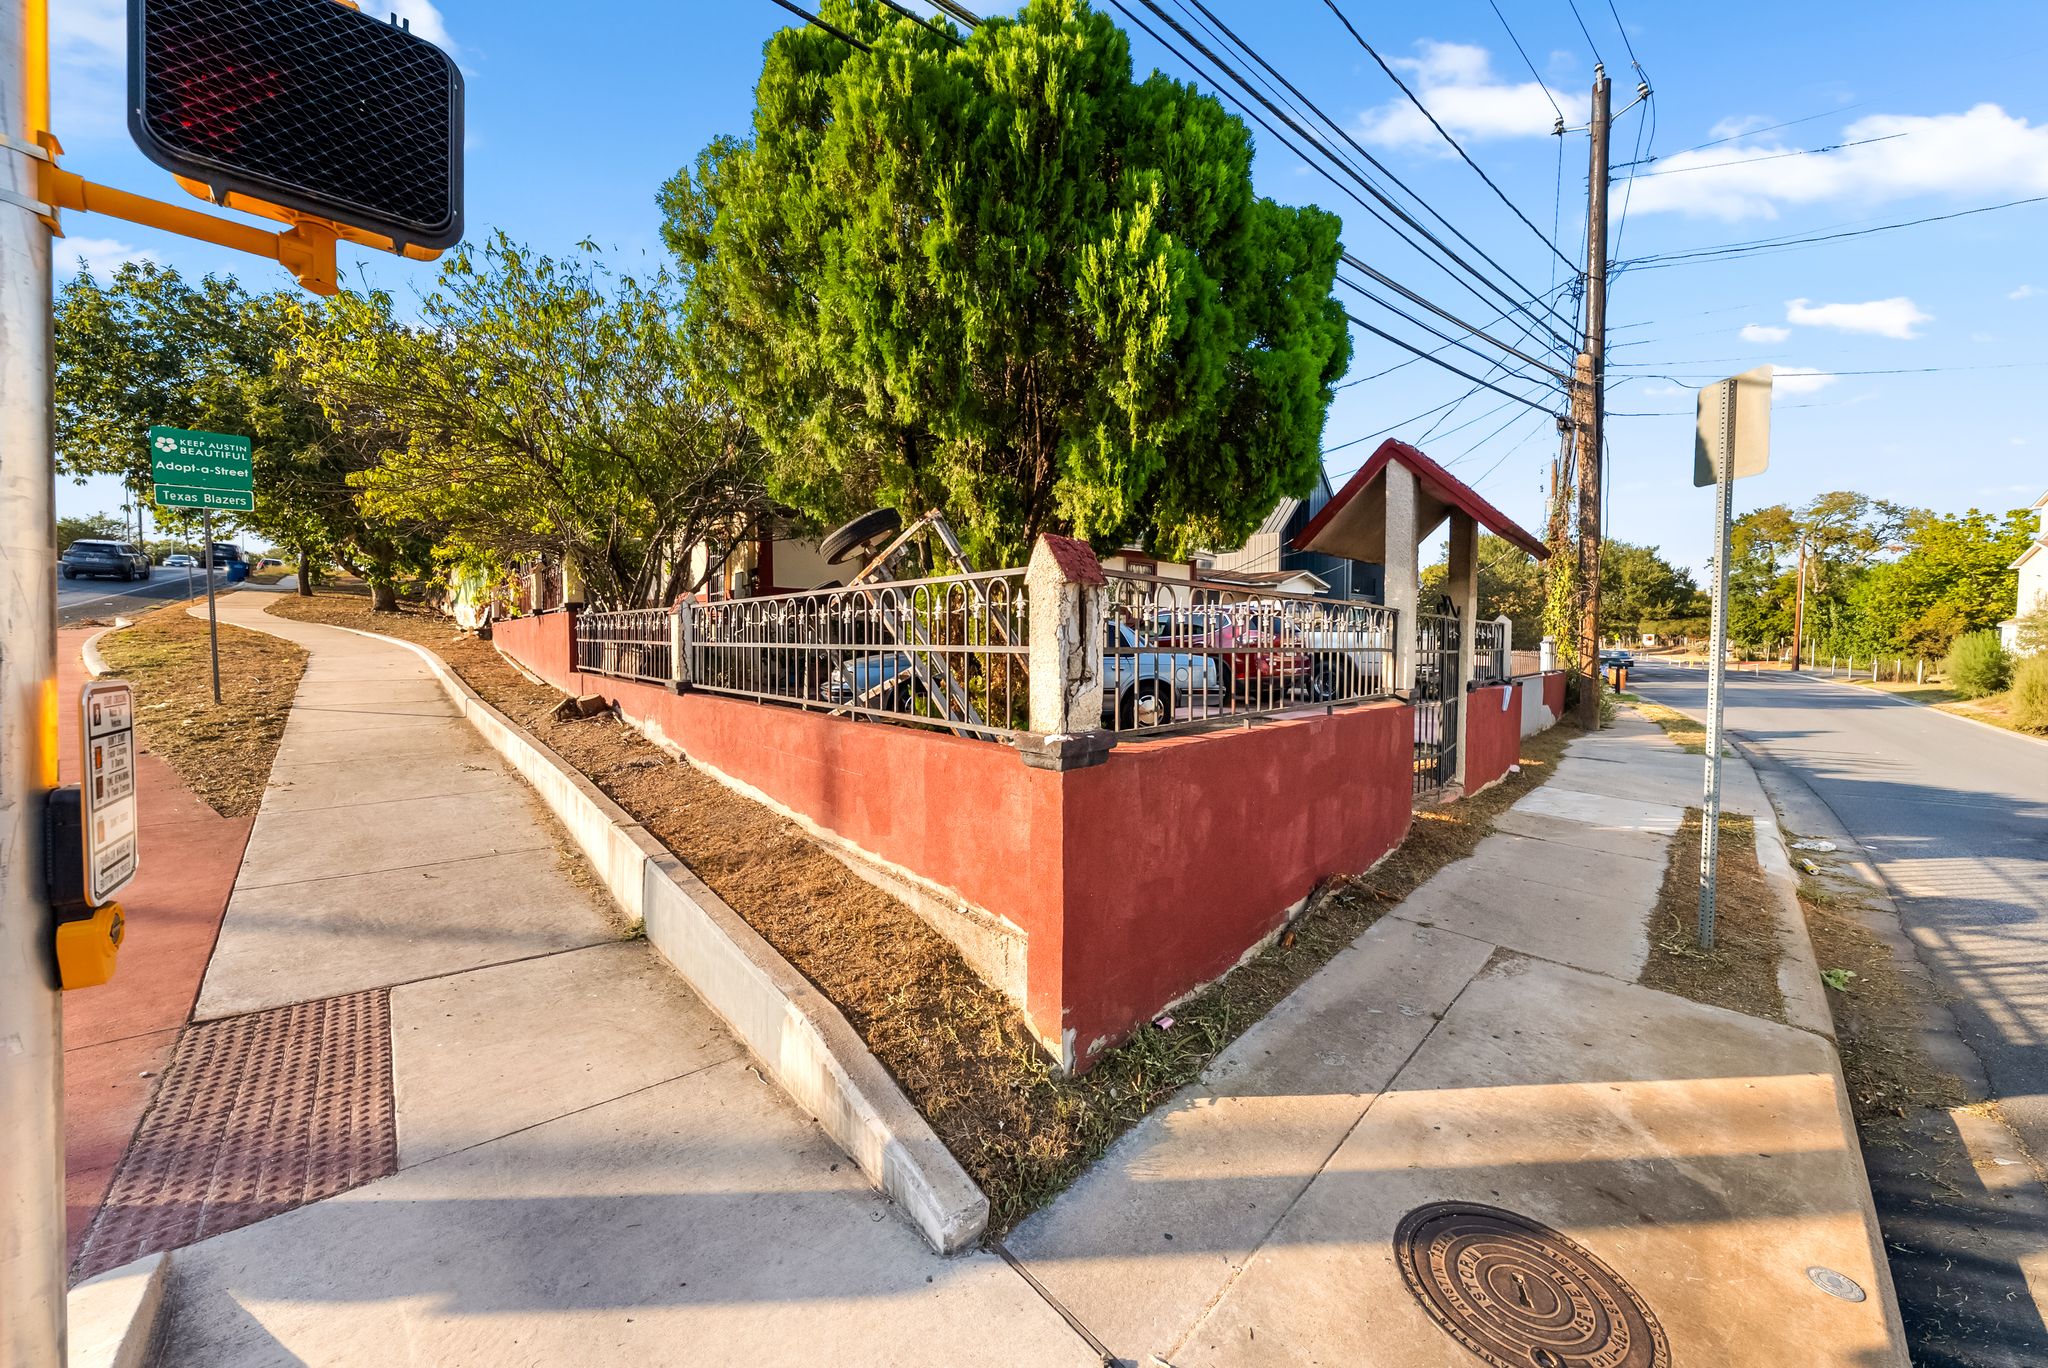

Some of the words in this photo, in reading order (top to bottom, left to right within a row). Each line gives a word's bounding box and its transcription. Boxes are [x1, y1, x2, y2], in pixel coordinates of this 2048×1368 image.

[180, 439, 205, 448] KEEP
[208, 442, 247, 452] AUSTIN
[180, 447, 247, 461] BEAUTIFUL
[155, 461, 249, 477] Adopt-a-Street
[162, 490, 198, 502] Texas
[203, 493, 247, 506] Blazers
[1459, 1249, 1487, 1302] STORM
[1556, 1276, 1595, 1333] SEWER
